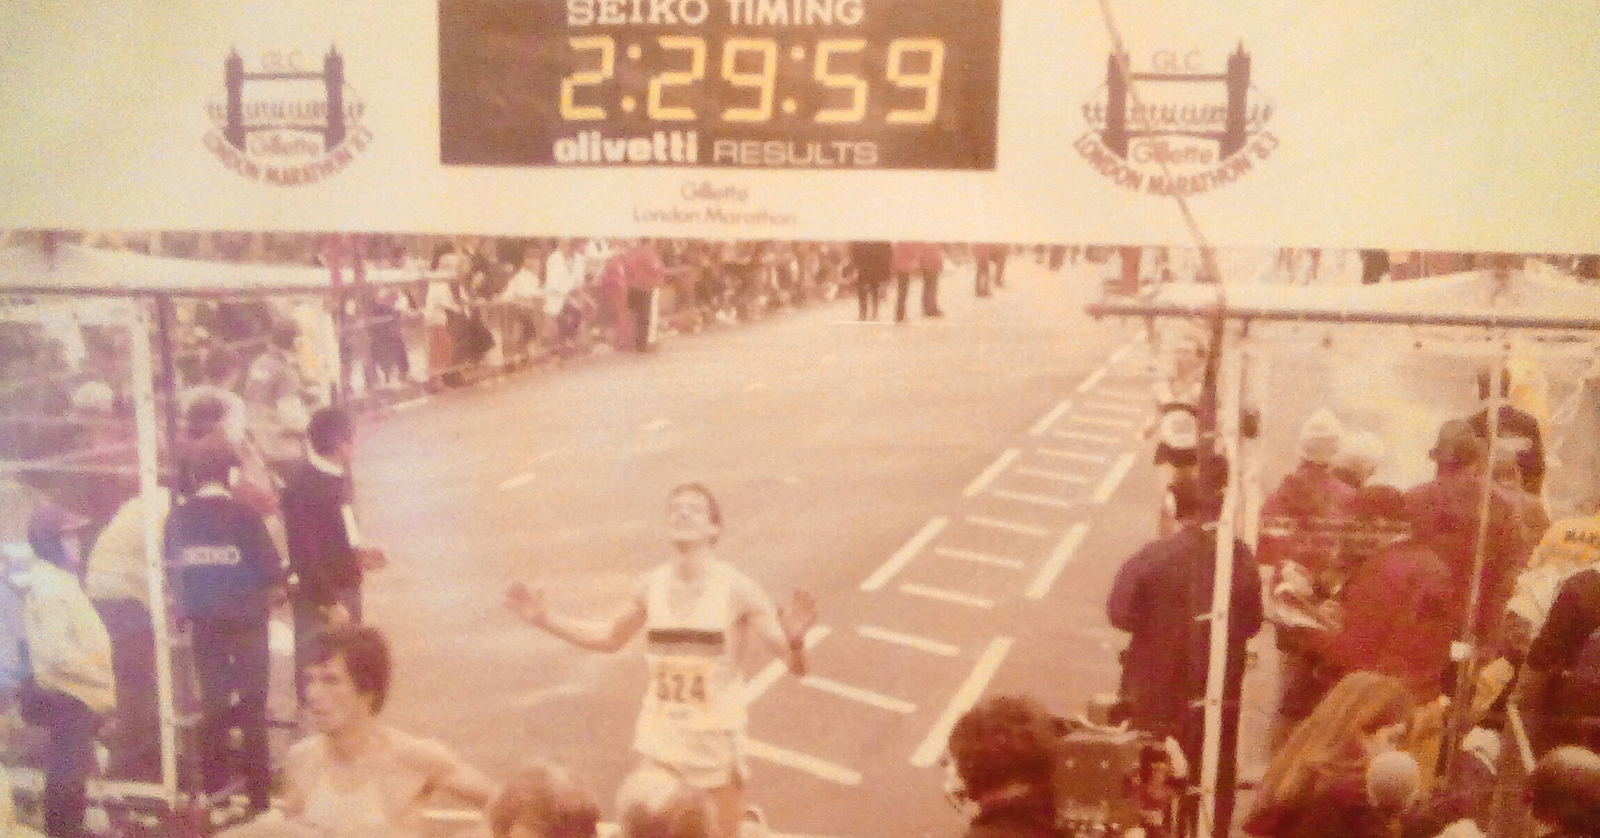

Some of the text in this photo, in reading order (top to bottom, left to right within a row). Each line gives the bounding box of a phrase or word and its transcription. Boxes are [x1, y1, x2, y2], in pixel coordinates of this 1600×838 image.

[566, 0, 866, 26] SEIKO TIMING
[1151, 48, 1203, 72] GLC
[560, 35, 945, 123] 2:29:59
[553, 130, 879, 165] olivetti RESULTS
[1132, 139, 1215, 165] Gillette
[1073, 130, 1144, 193] LONDON
[1147, 154, 1253, 197] MARATHON
[632, 205, 798, 226] London Marathon
